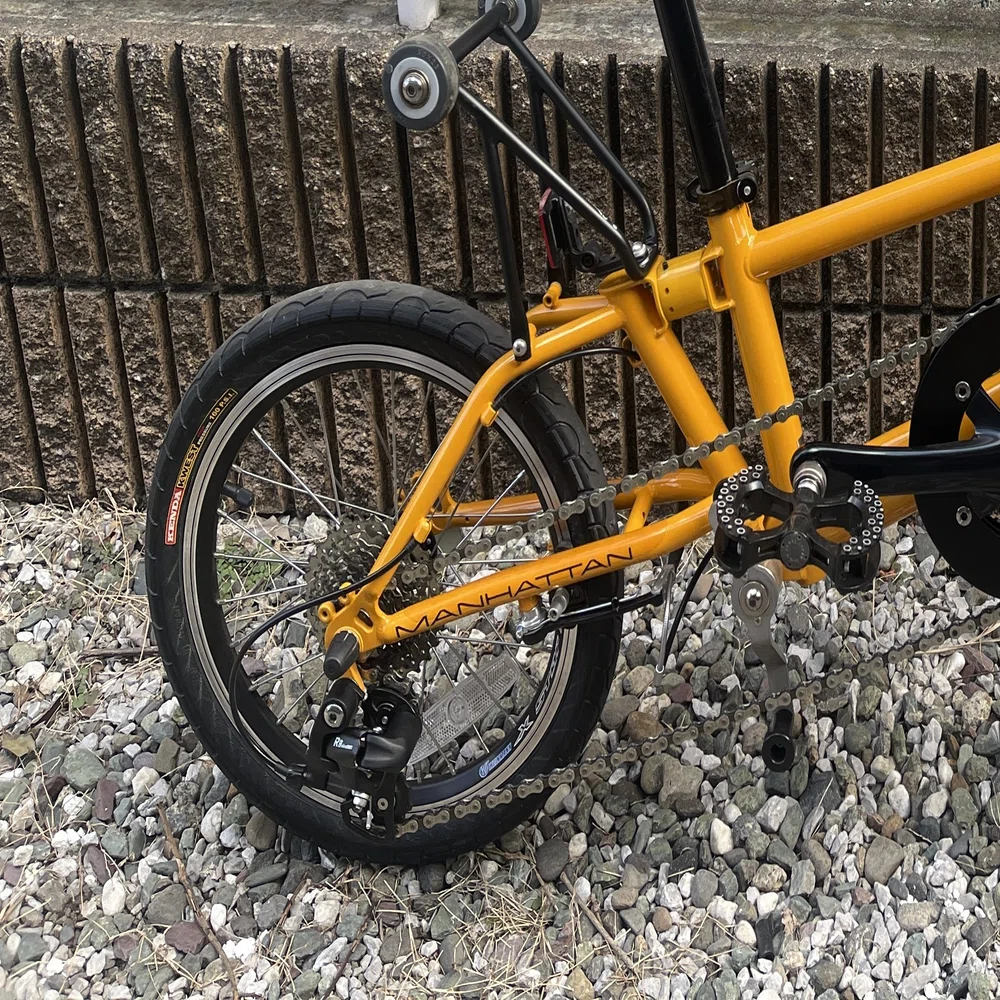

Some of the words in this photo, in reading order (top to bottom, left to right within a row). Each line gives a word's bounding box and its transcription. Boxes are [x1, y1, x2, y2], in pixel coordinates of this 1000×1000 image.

[167, 490, 182, 543] KENDA
[178, 443, 201, 487] KWEST
[209, 407, 221, 421] 100
[395, 547, 634, 638] MANHATTAN
[514, 714, 535, 748] X
